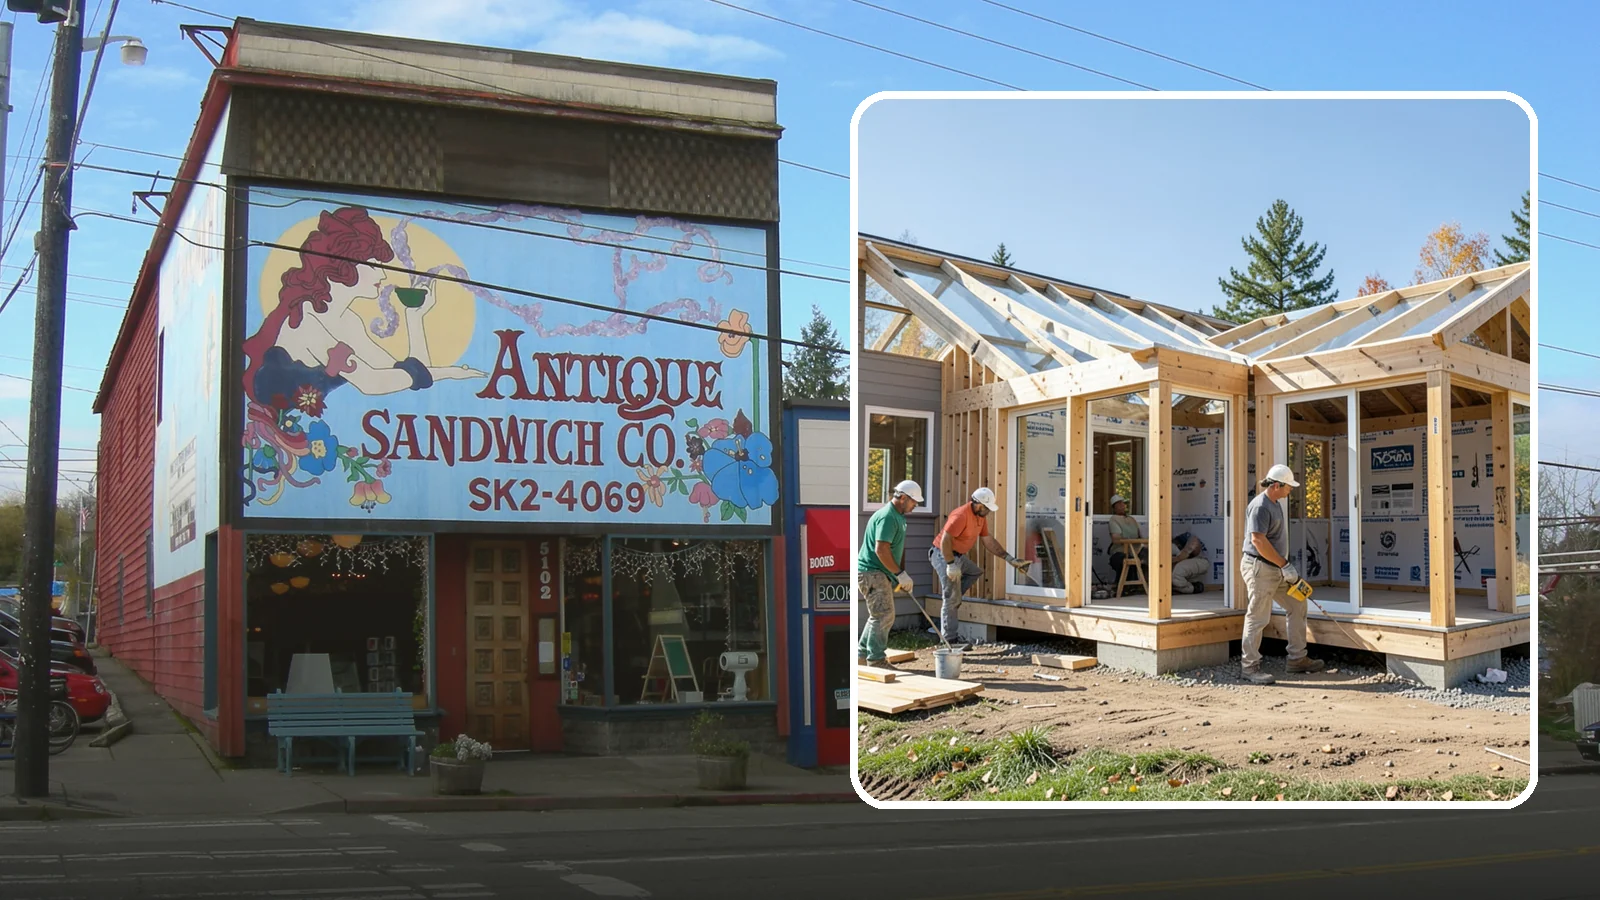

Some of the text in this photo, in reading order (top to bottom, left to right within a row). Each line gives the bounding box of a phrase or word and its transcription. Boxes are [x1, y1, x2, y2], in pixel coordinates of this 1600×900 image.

[475, 329, 723, 420] ANTIQUE
[361, 408, 684, 469] SANDWICH CO.
[469, 477, 645, 513] SK2-4069
[809, 555, 835, 569] BOOKS
